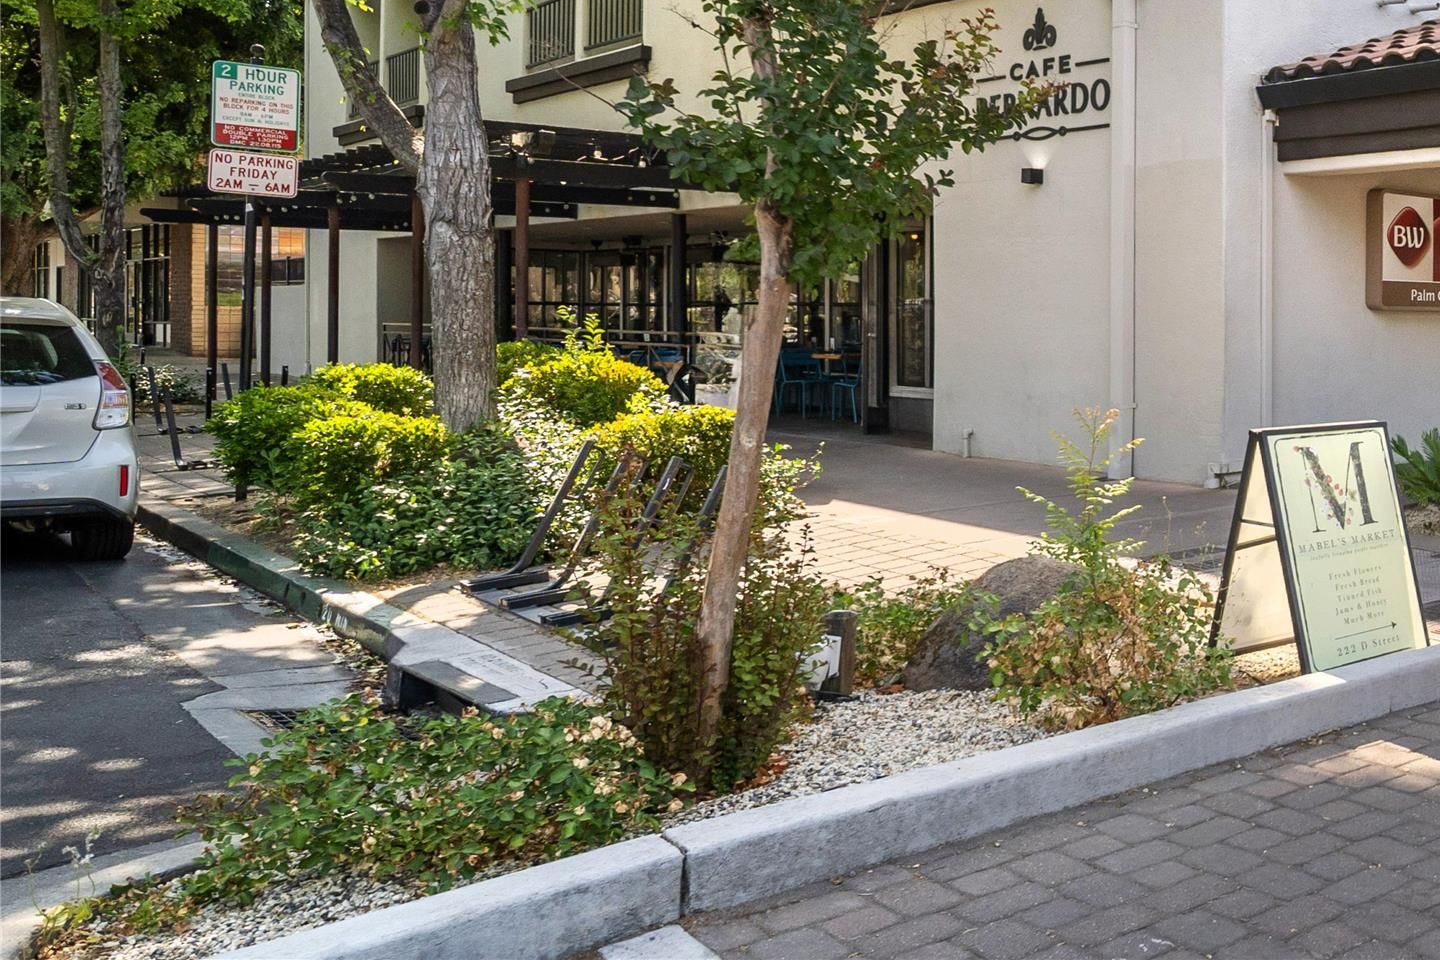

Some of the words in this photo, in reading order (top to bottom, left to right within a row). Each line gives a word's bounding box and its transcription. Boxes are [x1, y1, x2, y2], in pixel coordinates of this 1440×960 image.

[221, 64, 231, 77] 2
[246, 68, 287, 85] HOUR
[1009, 54, 1072, 82] CAFE
[230, 81, 284, 95] PARKING
[231, 97, 266, 106] REPARKING
[239, 127, 286, 136] COMMERCIAL
[215, 153, 232, 164] NO
[239, 155, 293, 170] PARKING
[230, 166, 277, 180] FRIDAY
[216, 178, 242, 189] 2AM
[265, 182, 290, 193] 6AM
[1393, 225, 1425, 249] BW
[1410, 288, 1436, 303] Palm
[1295, 441, 1378, 533] M
[1298, 537, 1347, 554] MABEL'S
[1350, 528, 1396, 546] MARKET
[1328, 568, 1351, 581] Fresh
[1353, 564, 1382, 577] Flowers
[1334, 580, 1357, 591] Fresh
[1359, 575, 1380, 586] Bread
[1335, 606, 1354, 616] Jams
[1343, 615, 1364, 625] Much
[1366, 610, 1385, 619] More
[1336, 643, 1357, 657] 222
[1360, 640, 1368, 651] D
[1371, 634, 1400, 648] Street
